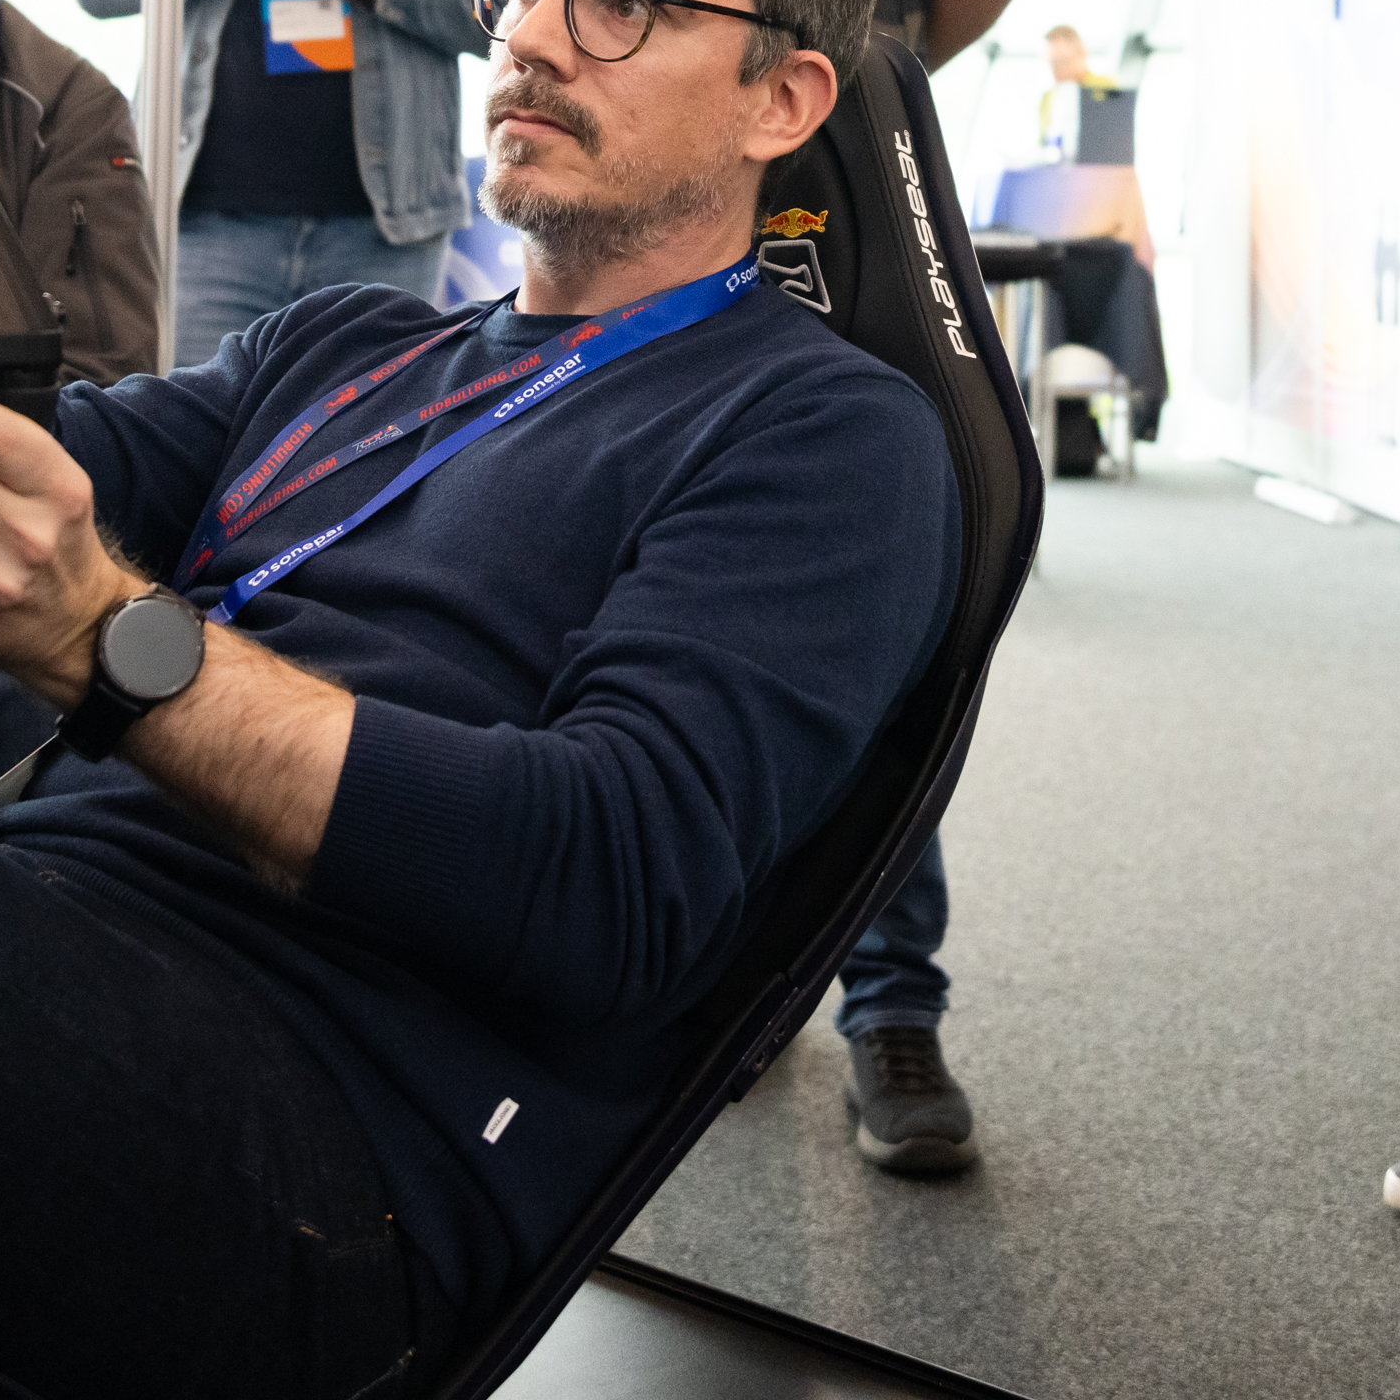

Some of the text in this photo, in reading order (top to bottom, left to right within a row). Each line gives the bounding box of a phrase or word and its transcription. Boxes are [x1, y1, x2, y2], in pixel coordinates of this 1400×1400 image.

[418, 353, 542, 421] REDBULLRING.COM
[514, 352, 582, 405] sonepar
[216, 422, 313, 525] REDBULLRING.COM
[226, 456, 338, 540] REDBULLRING.COM
[270, 524, 343, 573] sonepar
